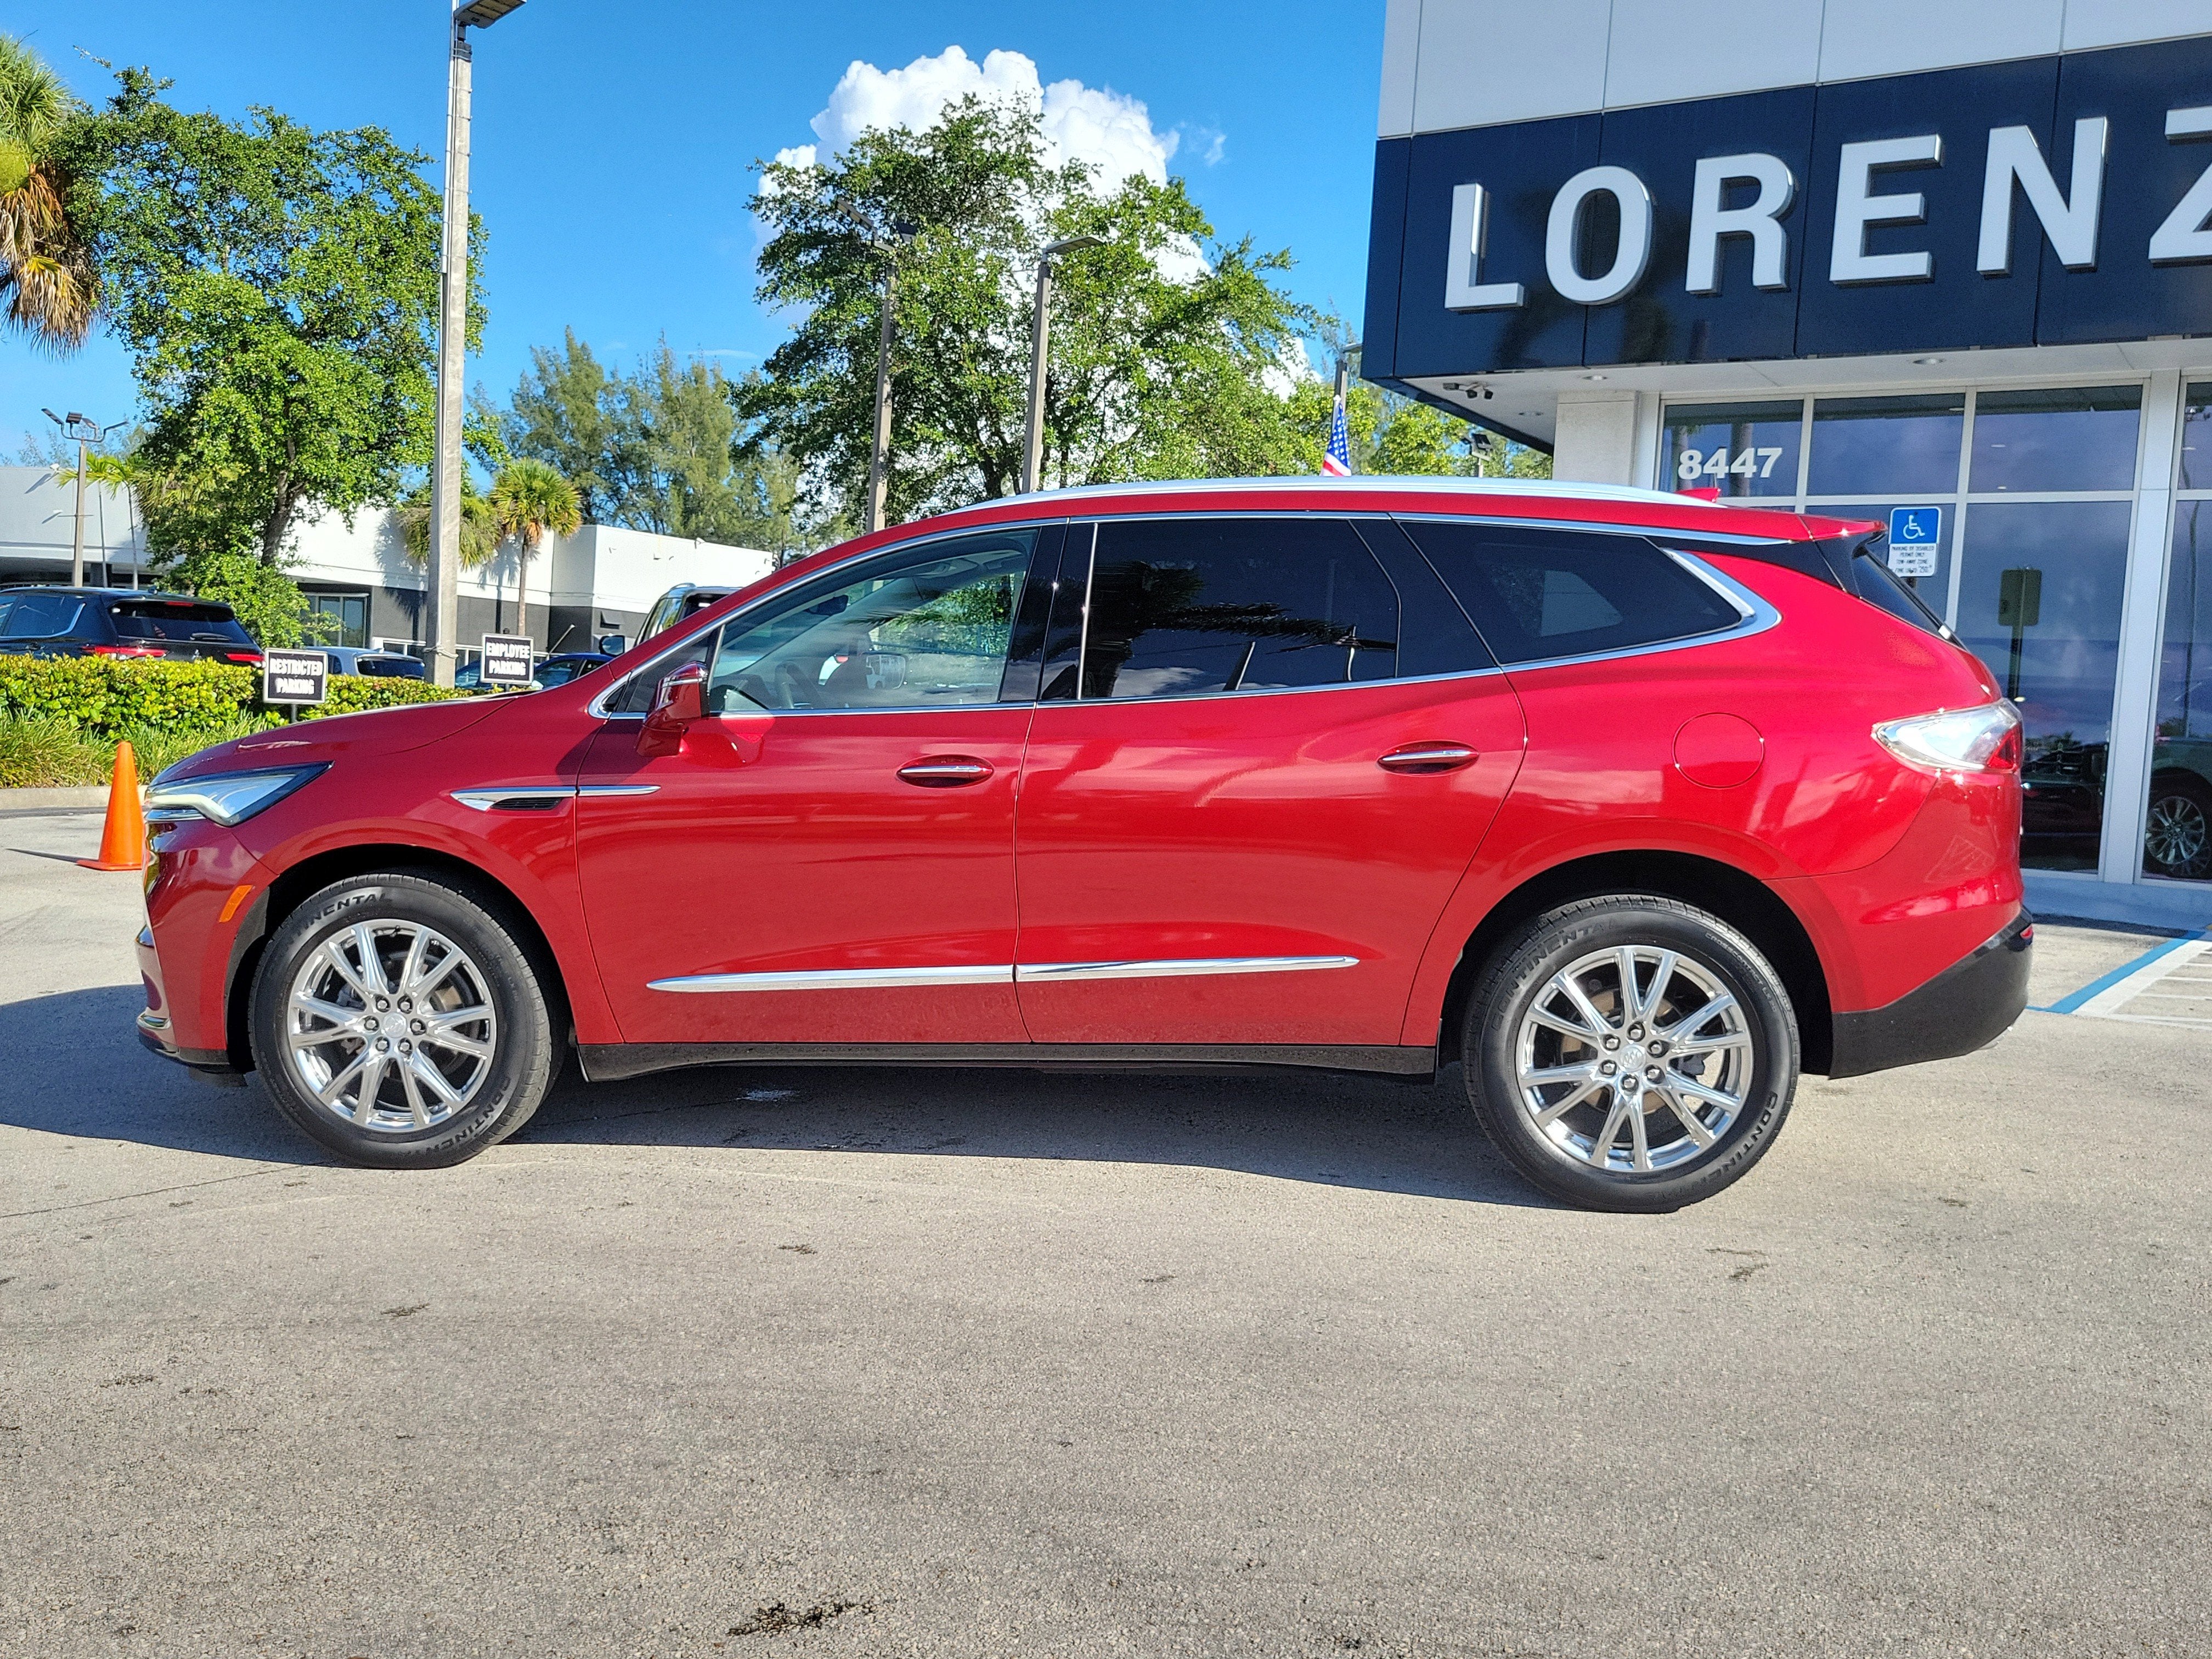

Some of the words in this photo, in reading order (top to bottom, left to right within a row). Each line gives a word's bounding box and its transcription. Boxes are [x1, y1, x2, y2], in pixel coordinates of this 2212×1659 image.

[1678, 447, 1782, 479] 8447
[486, 642, 531, 659] EMPLOYEE
[269, 658, 323, 676] RESTRICTED
[489, 658, 527, 676] PARKING
[276, 676, 315, 695] PARKING
[425, 1075, 512, 1153] CONTINEN
